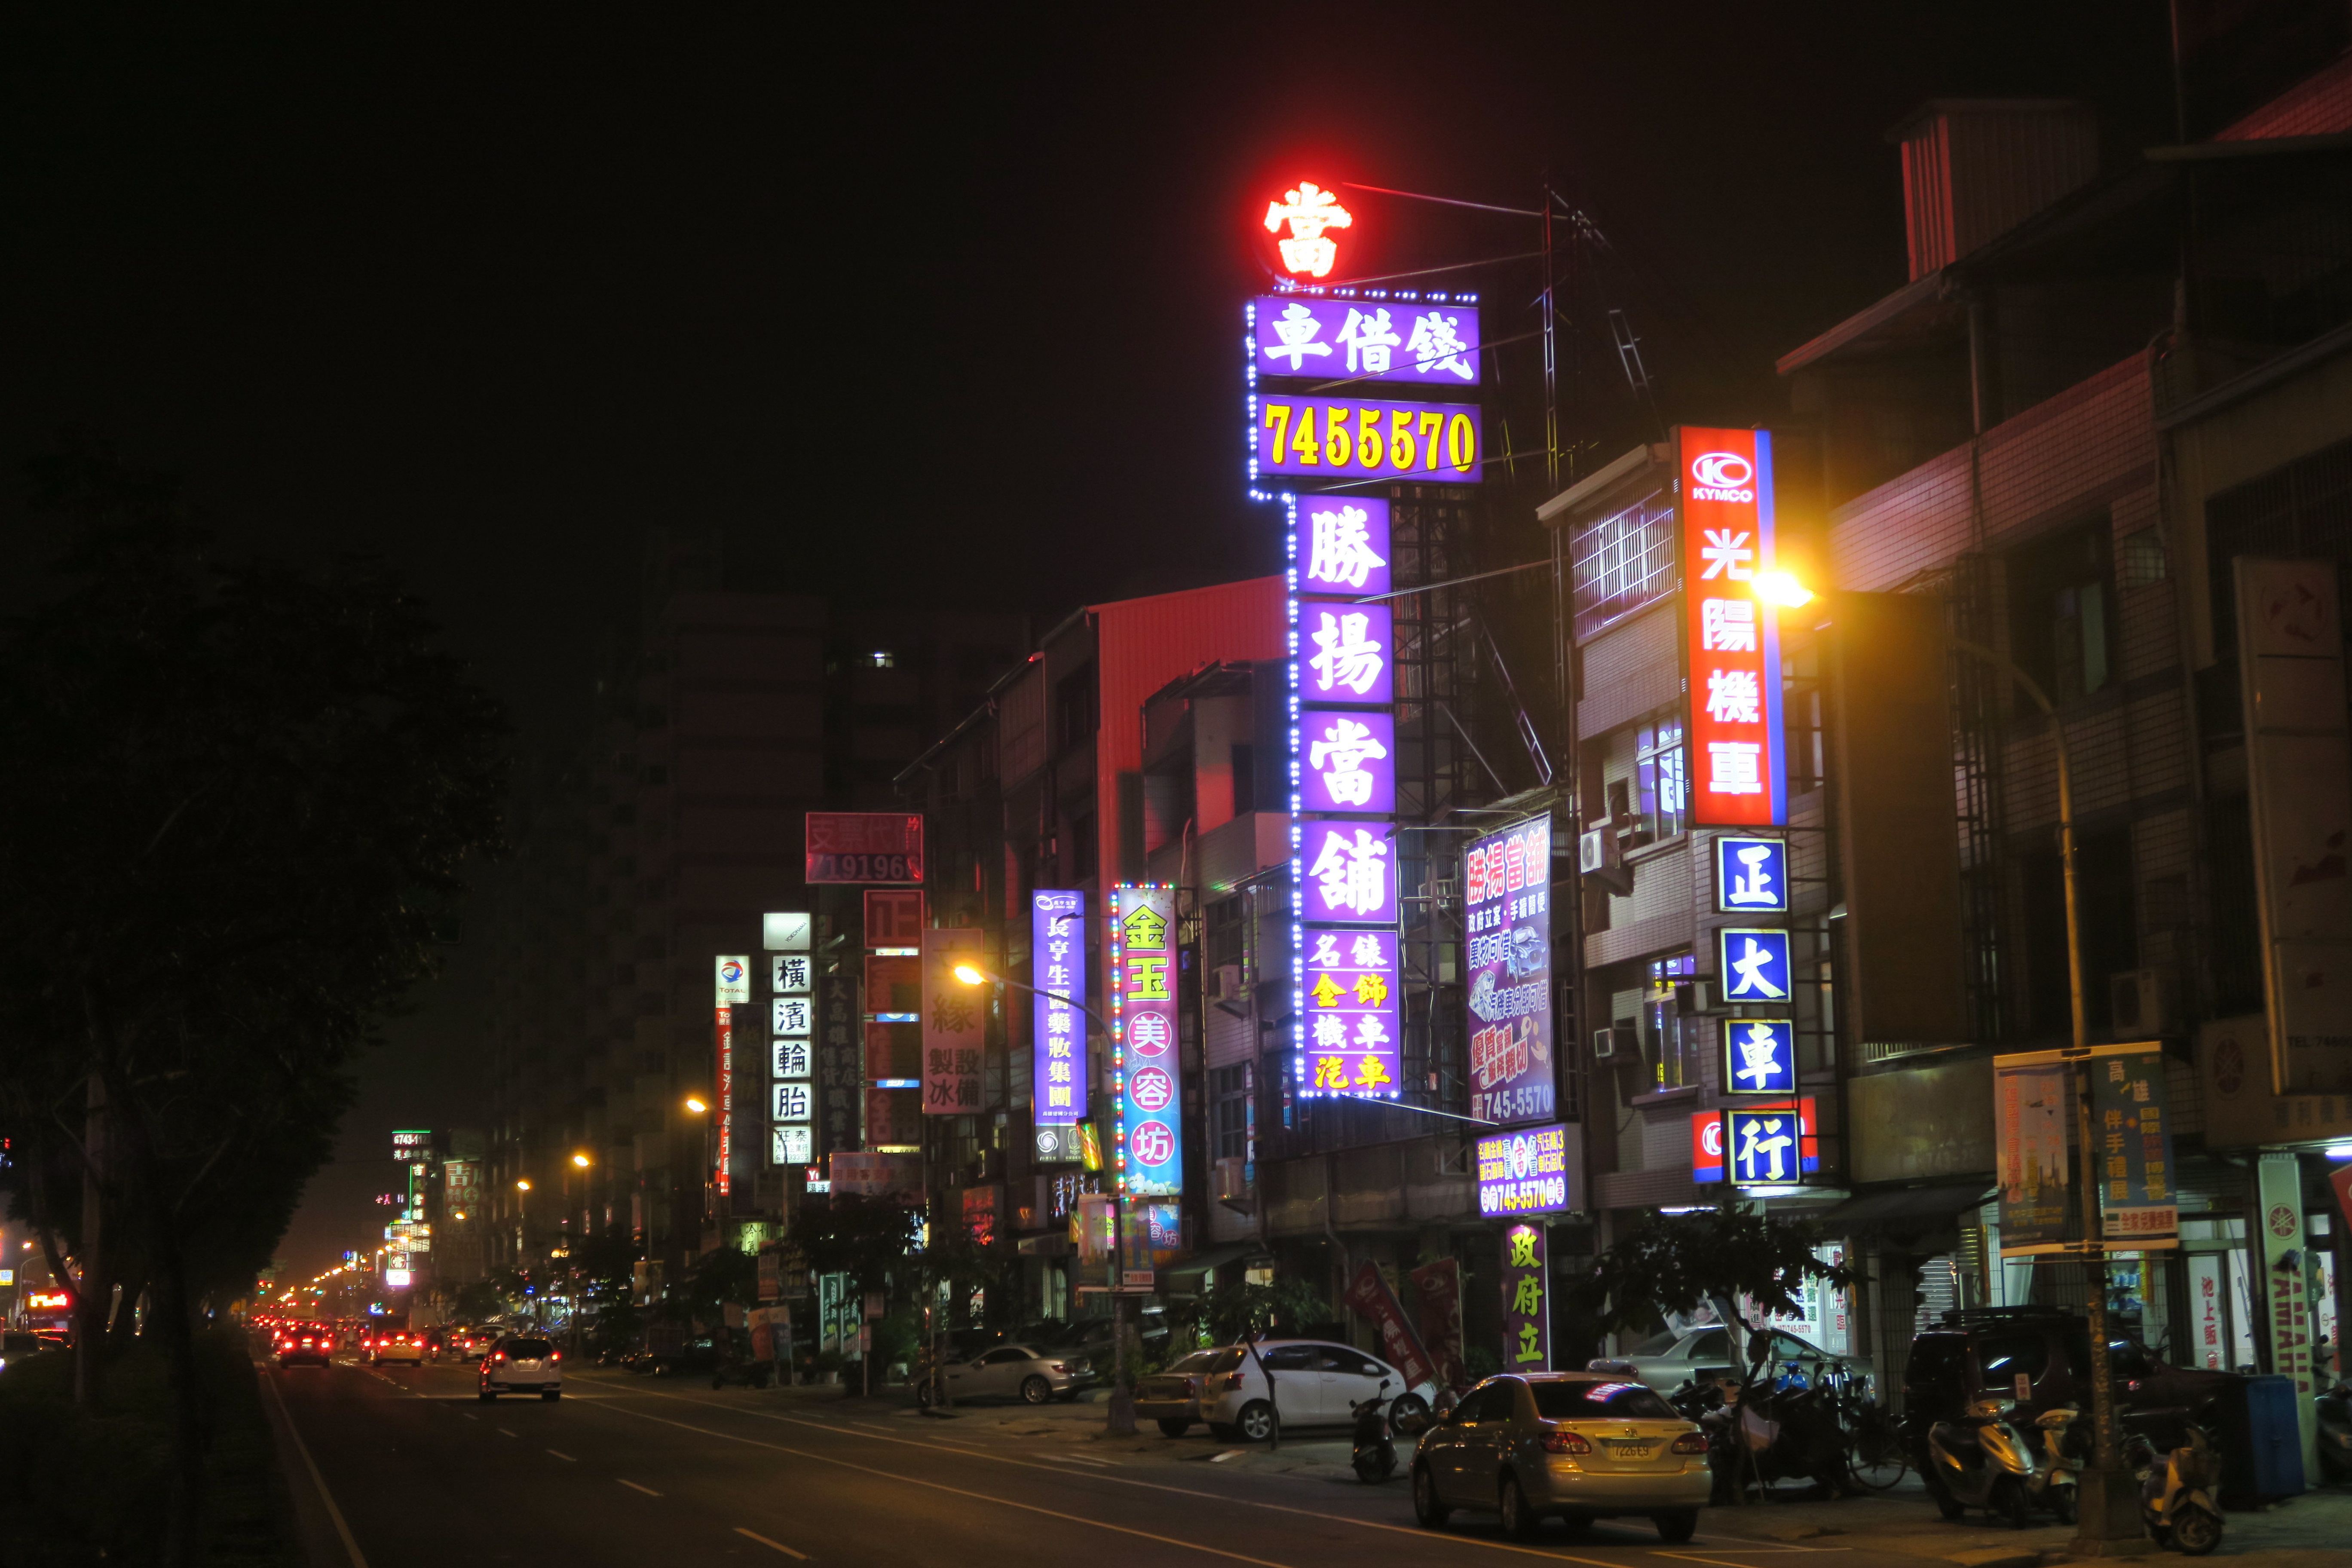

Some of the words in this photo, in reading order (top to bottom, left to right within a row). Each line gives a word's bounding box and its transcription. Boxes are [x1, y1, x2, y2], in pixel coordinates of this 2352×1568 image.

[1264, 181, 1352, 277] 當
[1264, 303, 1474, 380] 車借錢
[1265, 403, 1474, 472] 7455570
[1693, 487, 1753, 502] KYMCO
[1702, 529, 1761, 794] 光陽機車
[1467, 825, 1546, 906] 勝揚當舖
[785, 922, 807, 942] YOKOHAMA
[1469, 928, 1512, 971] 萬物可借
[1311, 973, 1388, 1008] 金飾
[1487, 979, 1547, 1022] 汽機車分期可借
[1312, 1014, 1390, 1049] 機車
[1729, 845, 1792, 1181] 正大車行
[778, 959, 805, 1117] 橫濱輪胎
[1315, 1054, 1391, 1089] 汽車
[1484, 1085, 1551, 1120] 745-5570
[1498, 1179, 1546, 1212] 745-5570
[1511, 1227, 1544, 1372] 政府立
